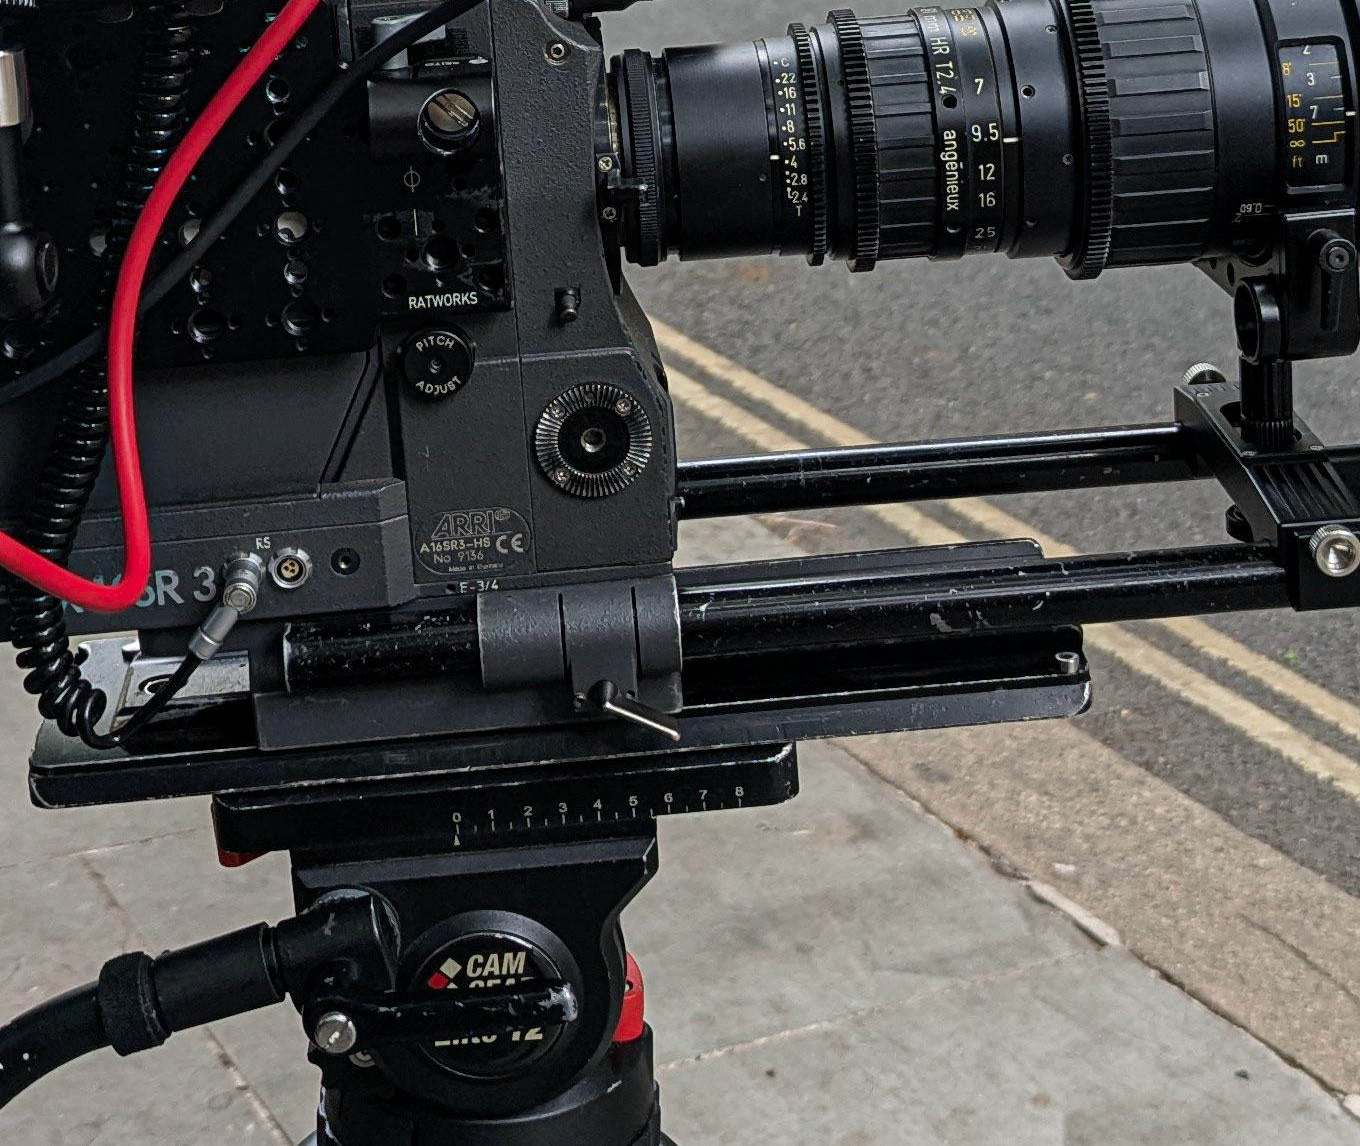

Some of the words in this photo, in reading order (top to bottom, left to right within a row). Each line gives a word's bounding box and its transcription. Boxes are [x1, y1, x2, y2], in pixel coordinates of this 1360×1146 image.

[930, 36, 950, 54] HR
[781, 58, 790, 66] C
[781, 72, 796, 84] 22
[936, 60, 957, 94] T2.4
[1306, 72, 1314, 86] 3
[784, 87, 796, 98] 16
[974, 78, 984, 95] 7
[786, 103, 796, 116] 11
[1310, 105, 1318, 120] 7
[786, 120, 795, 133] 8
[972, 122, 998, 142] 9.5
[788, 137, 806, 151] 5.6
[790, 156, 798, 168] 4
[1292, 155, 1302, 168] ft
[1316, 154, 1328, 164] m
[978, 163, 996, 180] 12
[790, 172, 808, 186] 2.8
[792, 190, 808, 204] 2.4
[978, 192, 996, 208] 16
[796, 206, 802, 216] T
[975, 227, 996, 238] 25
[408, 292, 478, 310] RATWORKS
[416, 336, 454, 352] PITCH
[416, 376, 462, 396] ADJUST
[430, 510, 495, 540] ARRI
[256, 537, 271, 550] RS
[420, 537, 490, 554] A16SR3-HS
[433, 554, 452, 564] No
[458, 550, 484, 562] 9136
[192, 566, 216, 602] 3
[452, 812, 462, 823] 0
[488, 810, 494, 820] 1
[524, 806, 532, 816] 2
[558, 802, 568, 813] 3
[593, 799, 602, 810] 4
[629, 796, 638, 806] 5
[664, 792, 673, 803] 6
[698, 790, 708, 800] 7
[734, 786, 744, 797] 8
[466, 951, 526, 978] CAM
